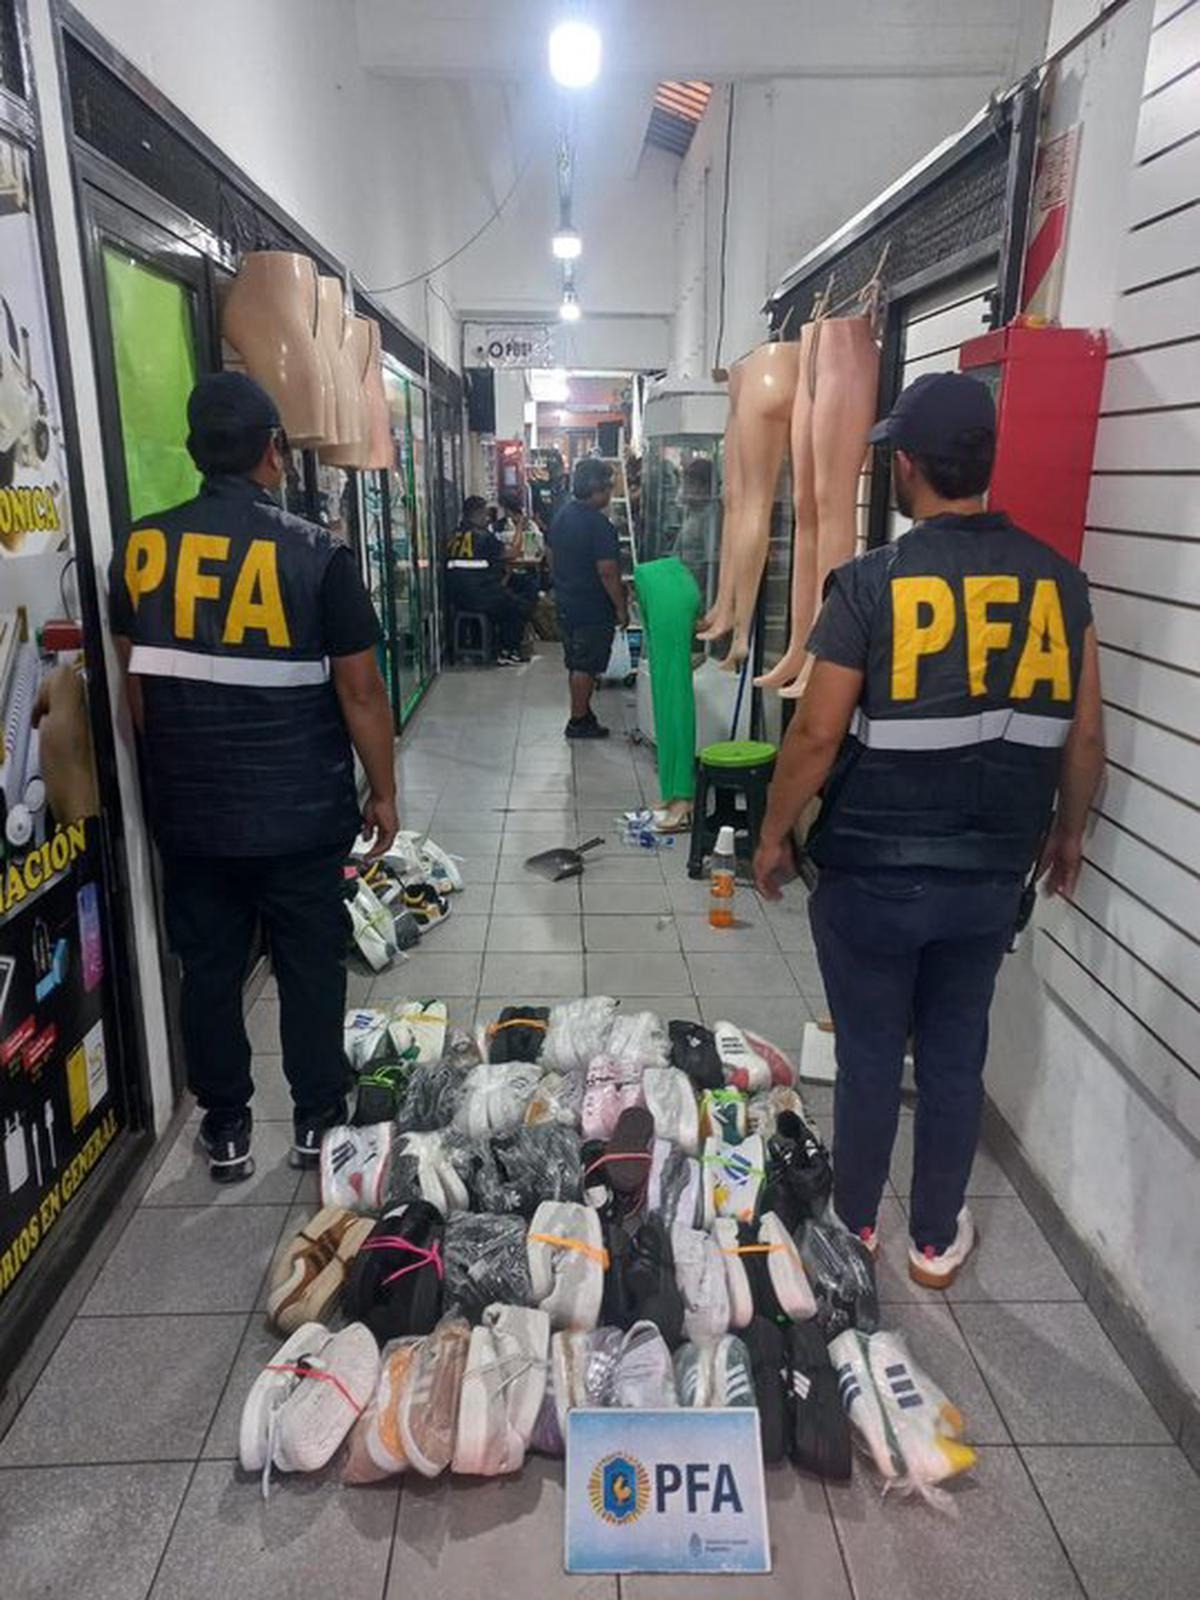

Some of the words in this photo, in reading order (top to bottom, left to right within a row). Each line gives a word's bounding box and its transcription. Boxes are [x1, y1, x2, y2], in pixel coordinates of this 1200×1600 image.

[124, 528, 290, 648] PFA
[891, 575, 1072, 702] PFA
[0, 818, 86, 914] ACIÓN
[0, 1214, 40, 1296] RIOS
[40, 1181, 62, 1236] EN
[61, 1107, 119, 1200] GENERAL
[655, 1463, 743, 1514] PFA
